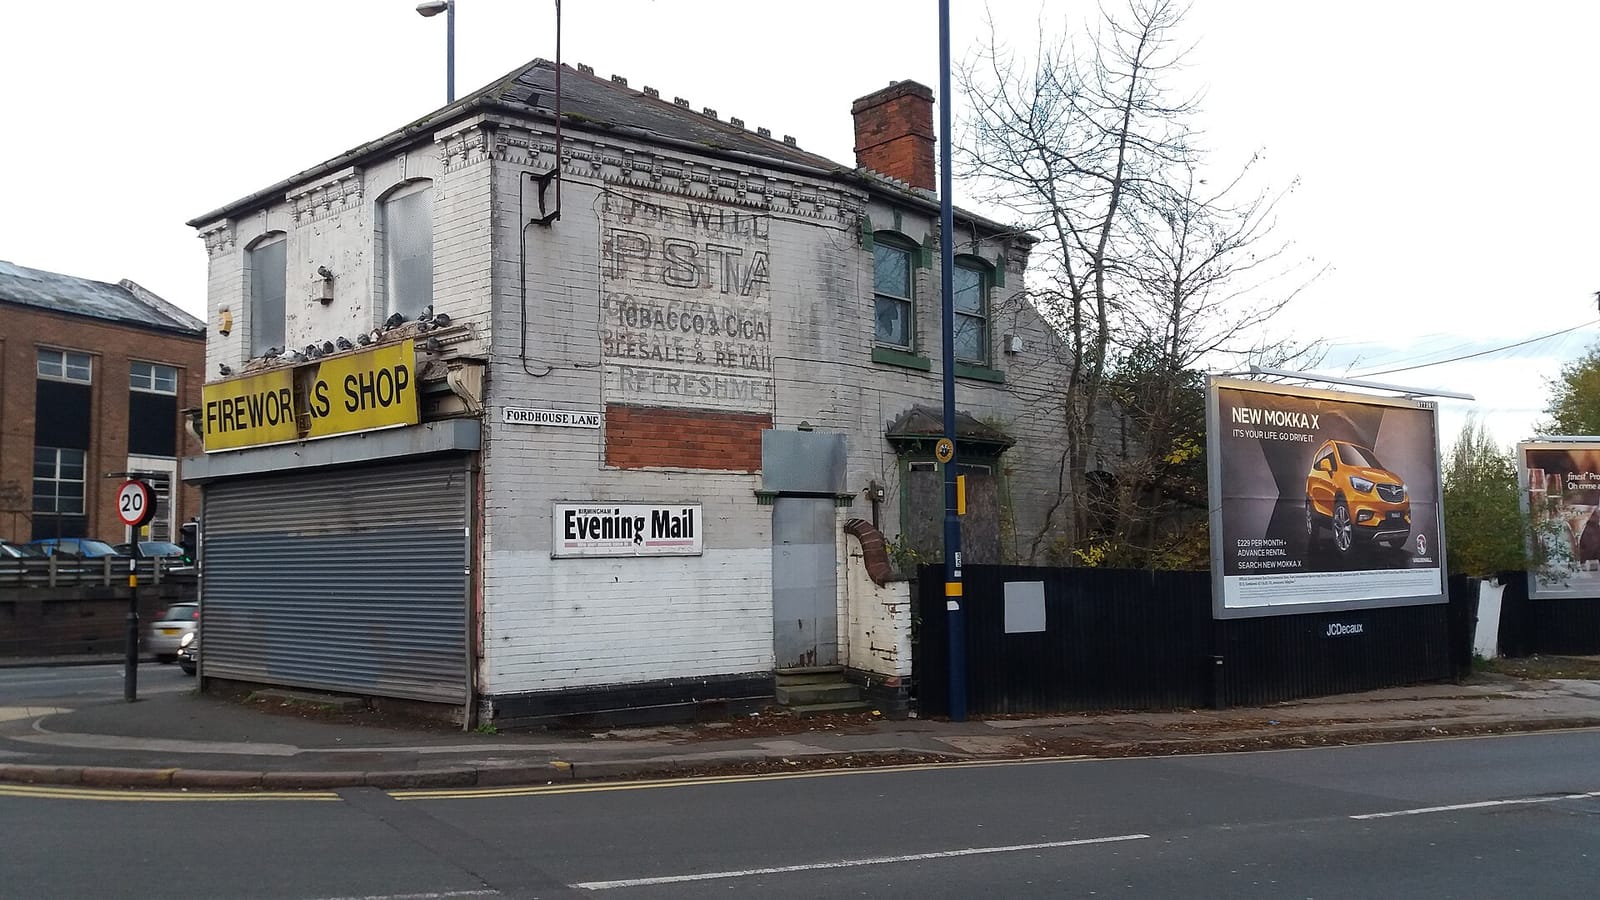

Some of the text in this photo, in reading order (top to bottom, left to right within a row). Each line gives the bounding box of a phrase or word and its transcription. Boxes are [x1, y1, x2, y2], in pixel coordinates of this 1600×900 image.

[618, 300, 706, 335] TOBACCO
[343, 364, 409, 413] SHOP
[506, 410, 599, 426] FORDHOUSE LANE
[1232, 406, 1320, 430] NEW MOKKA X
[1232, 428, 1244, 438] IT'S
[1245, 430, 1264, 440] YOUR
[1279, 432, 1289, 441] GO
[1289, 433, 1308, 443] DRIVE
[121, 493, 143, 512] 20
[564, 508, 694, 546] Evening Mail
[1237, 539, 1250, 547] £229
[1250, 539, 1262, 547] PER
[1262, 539, 1284, 547] MONTH
[1237, 548, 1287, 557] ADVANCE RENTAL
[1238, 561, 1263, 569] SEARCH
[1262, 561, 1276, 569] NEW
[1276, 560, 1297, 568] MOKKA
[1326, 623, 1364, 637] JCDecaux
